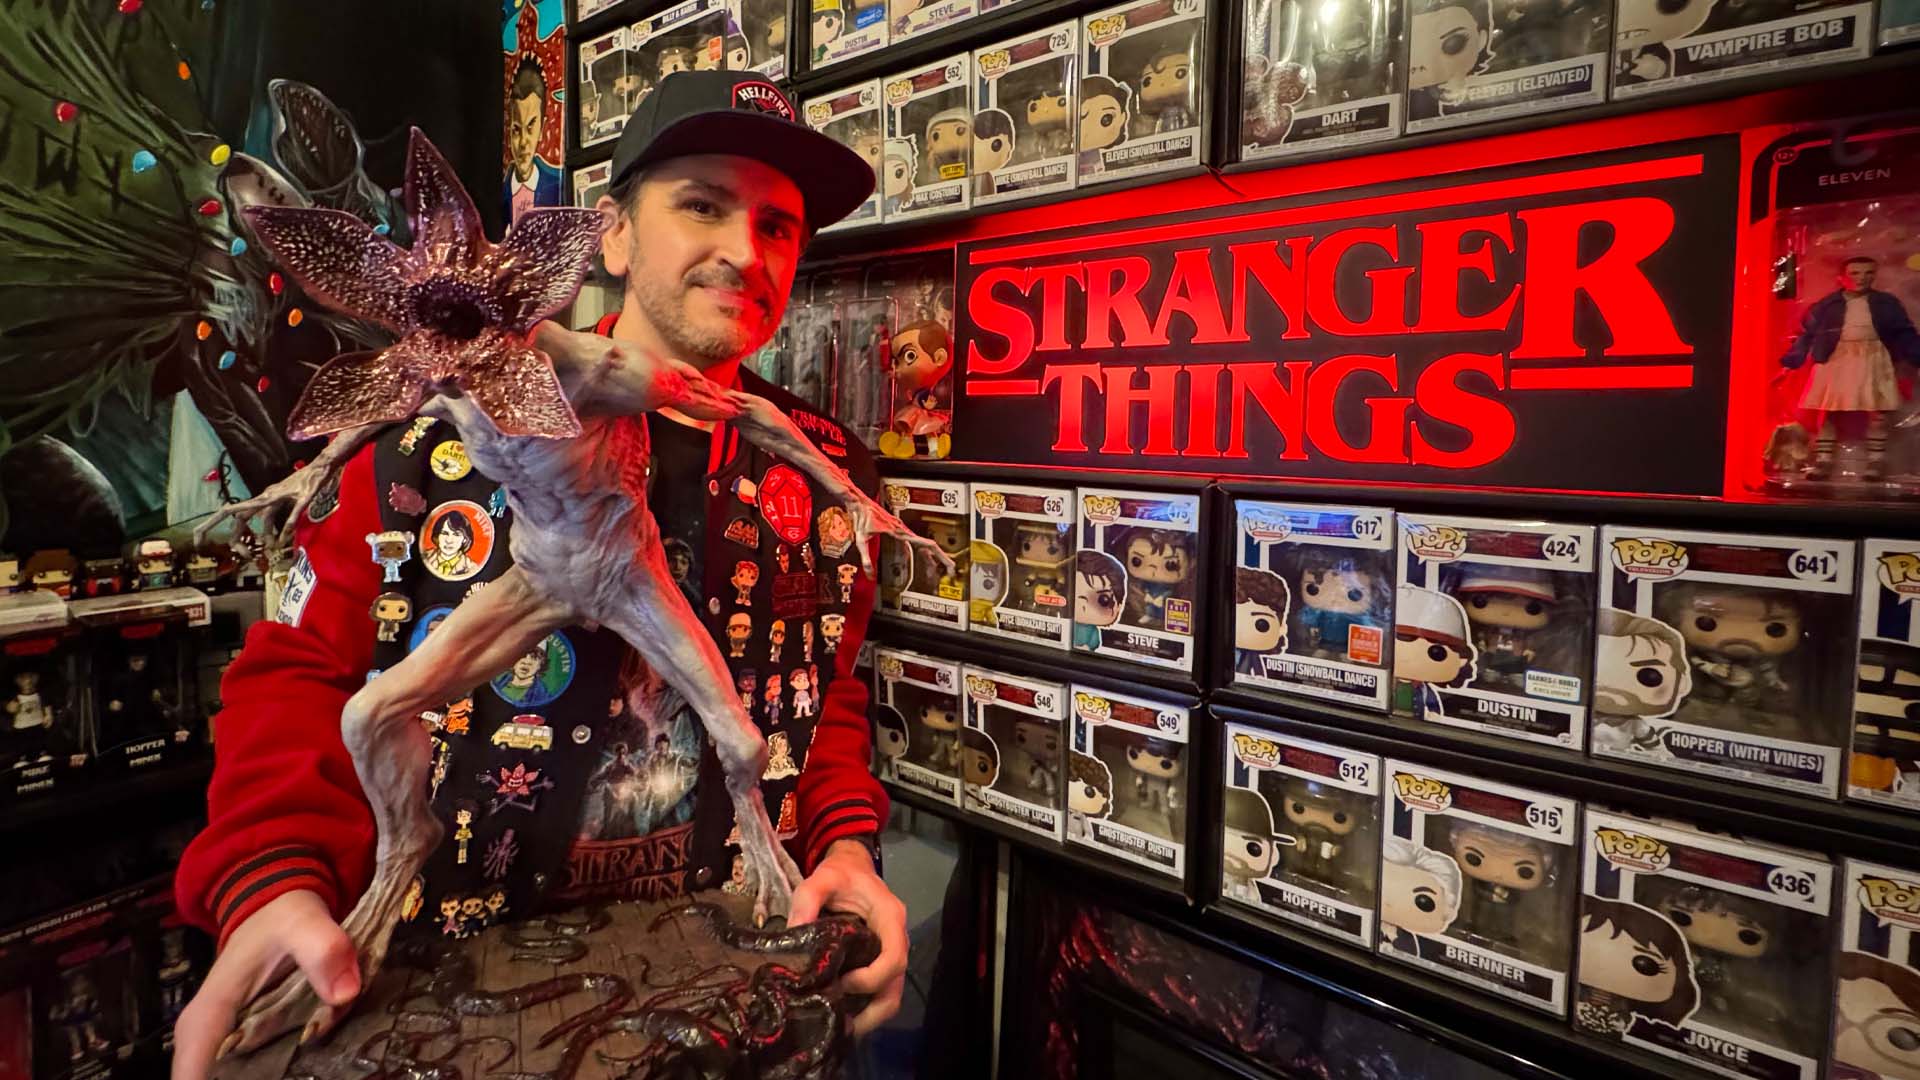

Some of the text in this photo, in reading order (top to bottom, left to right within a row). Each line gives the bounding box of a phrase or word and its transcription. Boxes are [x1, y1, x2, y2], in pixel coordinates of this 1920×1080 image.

[929, 3, 955, 19] STEVE
[844, 35, 868, 49] DUSTIN
[1051, 33, 1067, 47] 729
[1687, 19, 1844, 62] VAMPIRE BOB
[1518, 67, 1591, 93] (ELEVATED)
[737, 86, 790, 117] HELLFIRE
[1321, 109, 1360, 128] DART
[1105, 151, 1129, 163] ELEVEN
[1165, 136, 1191, 153] DANCE)
[1818, 168, 1891, 187] ELEVEN
[967, 197, 1694, 375] STRANGER
[1042, 353, 1516, 469] THINGS
[780, 495, 802, 518] 11
[1046, 500, 1061, 513] 526
[1083, 494, 1121, 515] POP!
[1355, 520, 1379, 537] 617
[1545, 538, 1577, 558] 424
[1610, 537, 1688, 568] POP!
[1794, 555, 1829, 576] 641
[1876, 551, 1920, 585] PO
[1127, 633, 1159, 649] STEVE
[547, 635, 572, 674] DUSTIN
[1266, 657, 1376, 688] DUSTIN (SNOWBALL DANCE)
[1036, 695, 1051, 708] 548
[1075, 692, 1111, 716] POP!
[1478, 699, 1537, 722] DUSTIN
[1159, 715, 1177, 730] 549
[1233, 733, 1279, 766] POP!
[1671, 733, 1824, 773] HOPPER (WITH VINES)
[1342, 762, 1367, 781] 512
[1392, 770, 1451, 804] POP!
[1031, 808, 1054, 825] LUCAS
[1529, 806, 1559, 828] 515
[1098, 825, 1174, 859] GHOSTBUSTER DUSTIN
[1594, 825, 1670, 864] POP!
[1771, 873, 1811, 896] 436
[1856, 874, 1920, 914] PO
[1282, 891, 1337, 920] HOPPER
[1446, 945, 1527, 983] BRENNER
[1684, 1031, 1750, 1064] JOYCE
